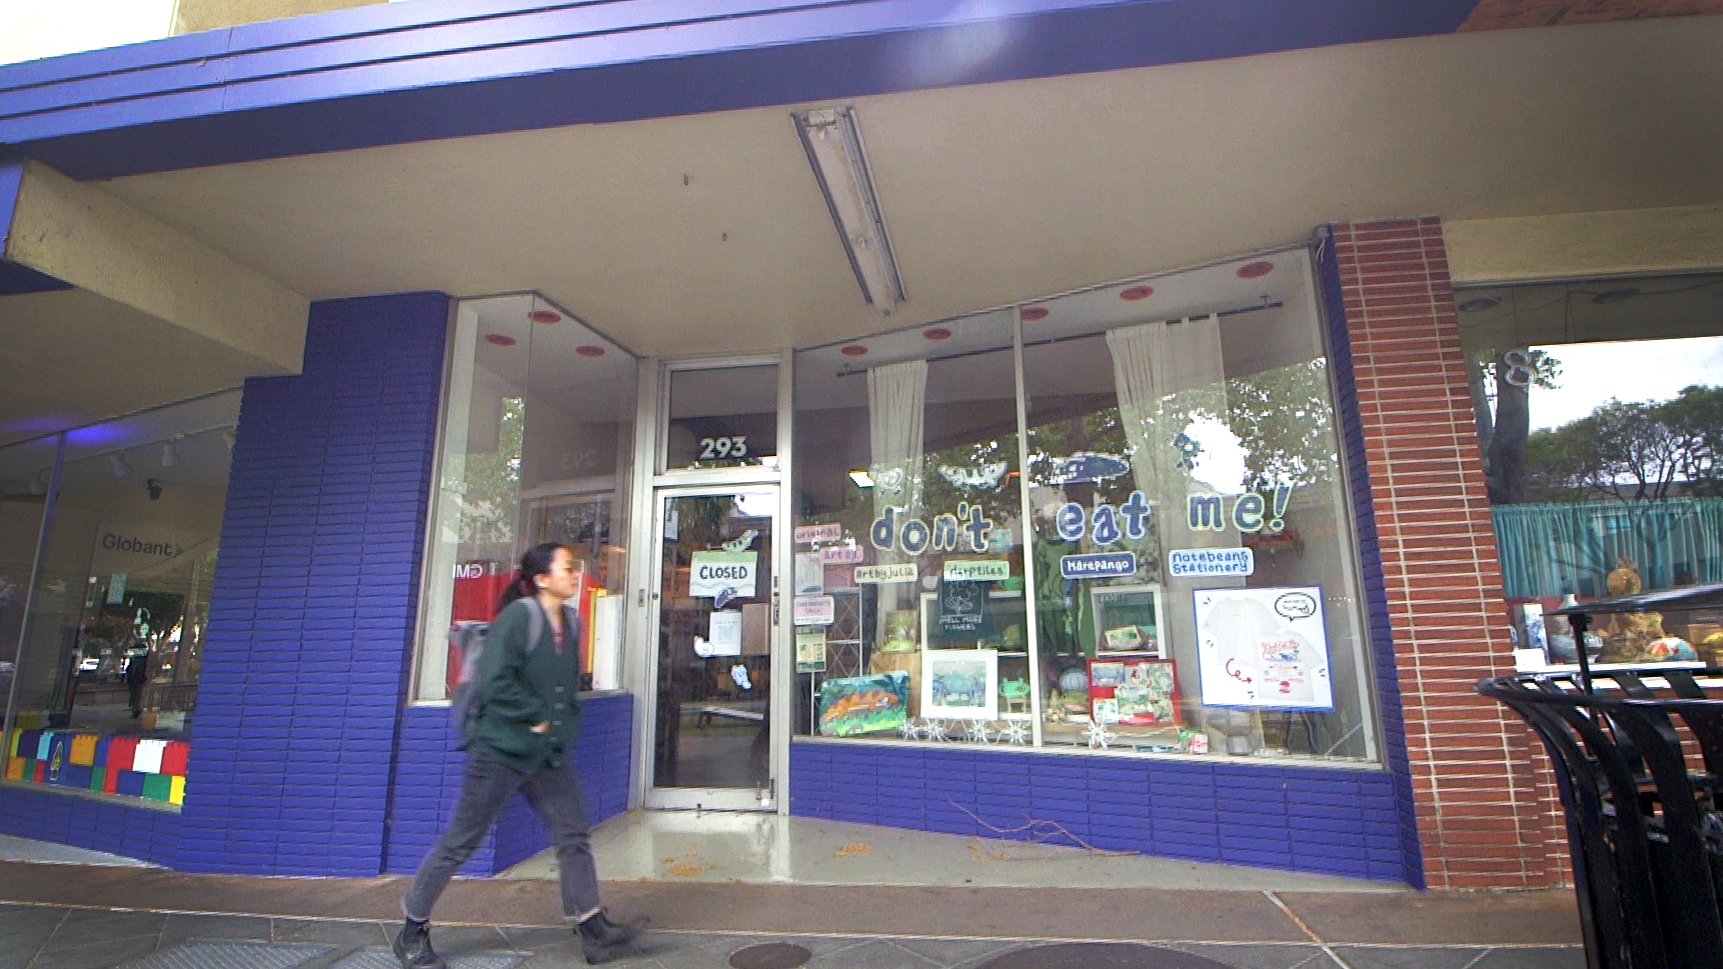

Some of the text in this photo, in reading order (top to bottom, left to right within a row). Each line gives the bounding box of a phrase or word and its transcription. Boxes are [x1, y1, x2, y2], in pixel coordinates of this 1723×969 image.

[700, 435, 748, 460] 293
[870, 481, 1295, 555] don't eat me!
[102, 533, 173, 557] Globant
[699, 566, 748, 580] CLOSED
[856, 566, 914, 580] artbyjulia
